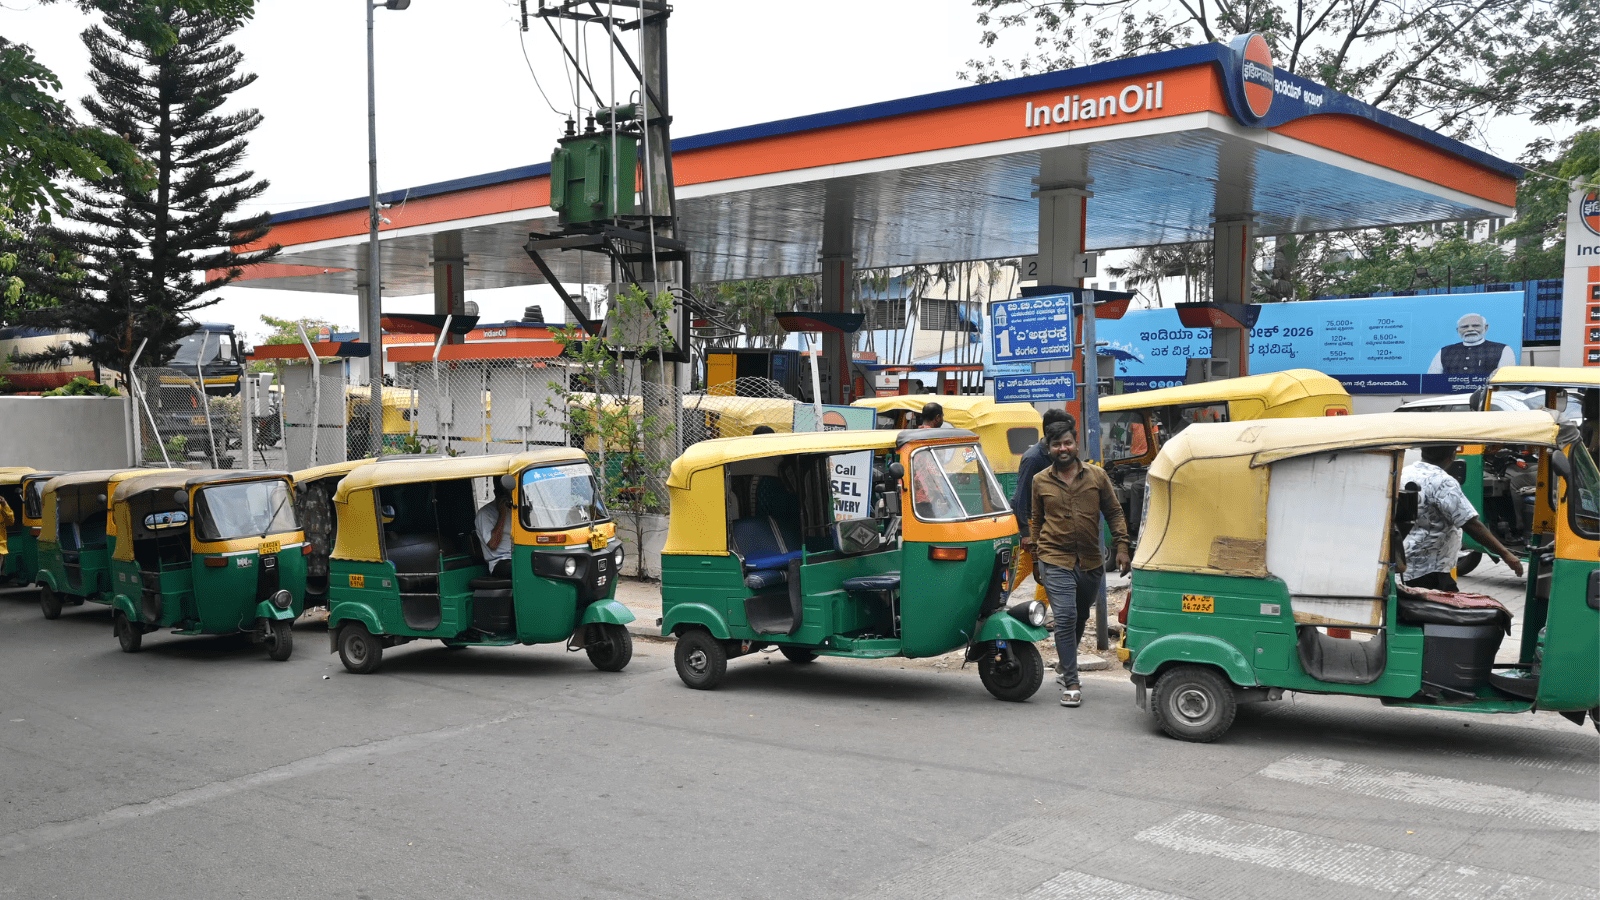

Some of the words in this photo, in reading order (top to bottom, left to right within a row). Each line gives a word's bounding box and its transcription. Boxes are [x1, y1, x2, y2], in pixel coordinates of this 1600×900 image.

[1025, 81, 1163, 128] IndianOil
[1028, 262, 1038, 276] 2
[1082, 258, 1088, 273] 1
[483, 329, 507, 337] IndianOil
[1139, 329, 1193, 342] ಇಂಡಿಯಾ
[1282, 327, 1314, 338] 2026
[1151, 346, 1169, 356] ಏಕ
[835, 464, 856, 476] Call
[831, 480, 861, 497] SEL
